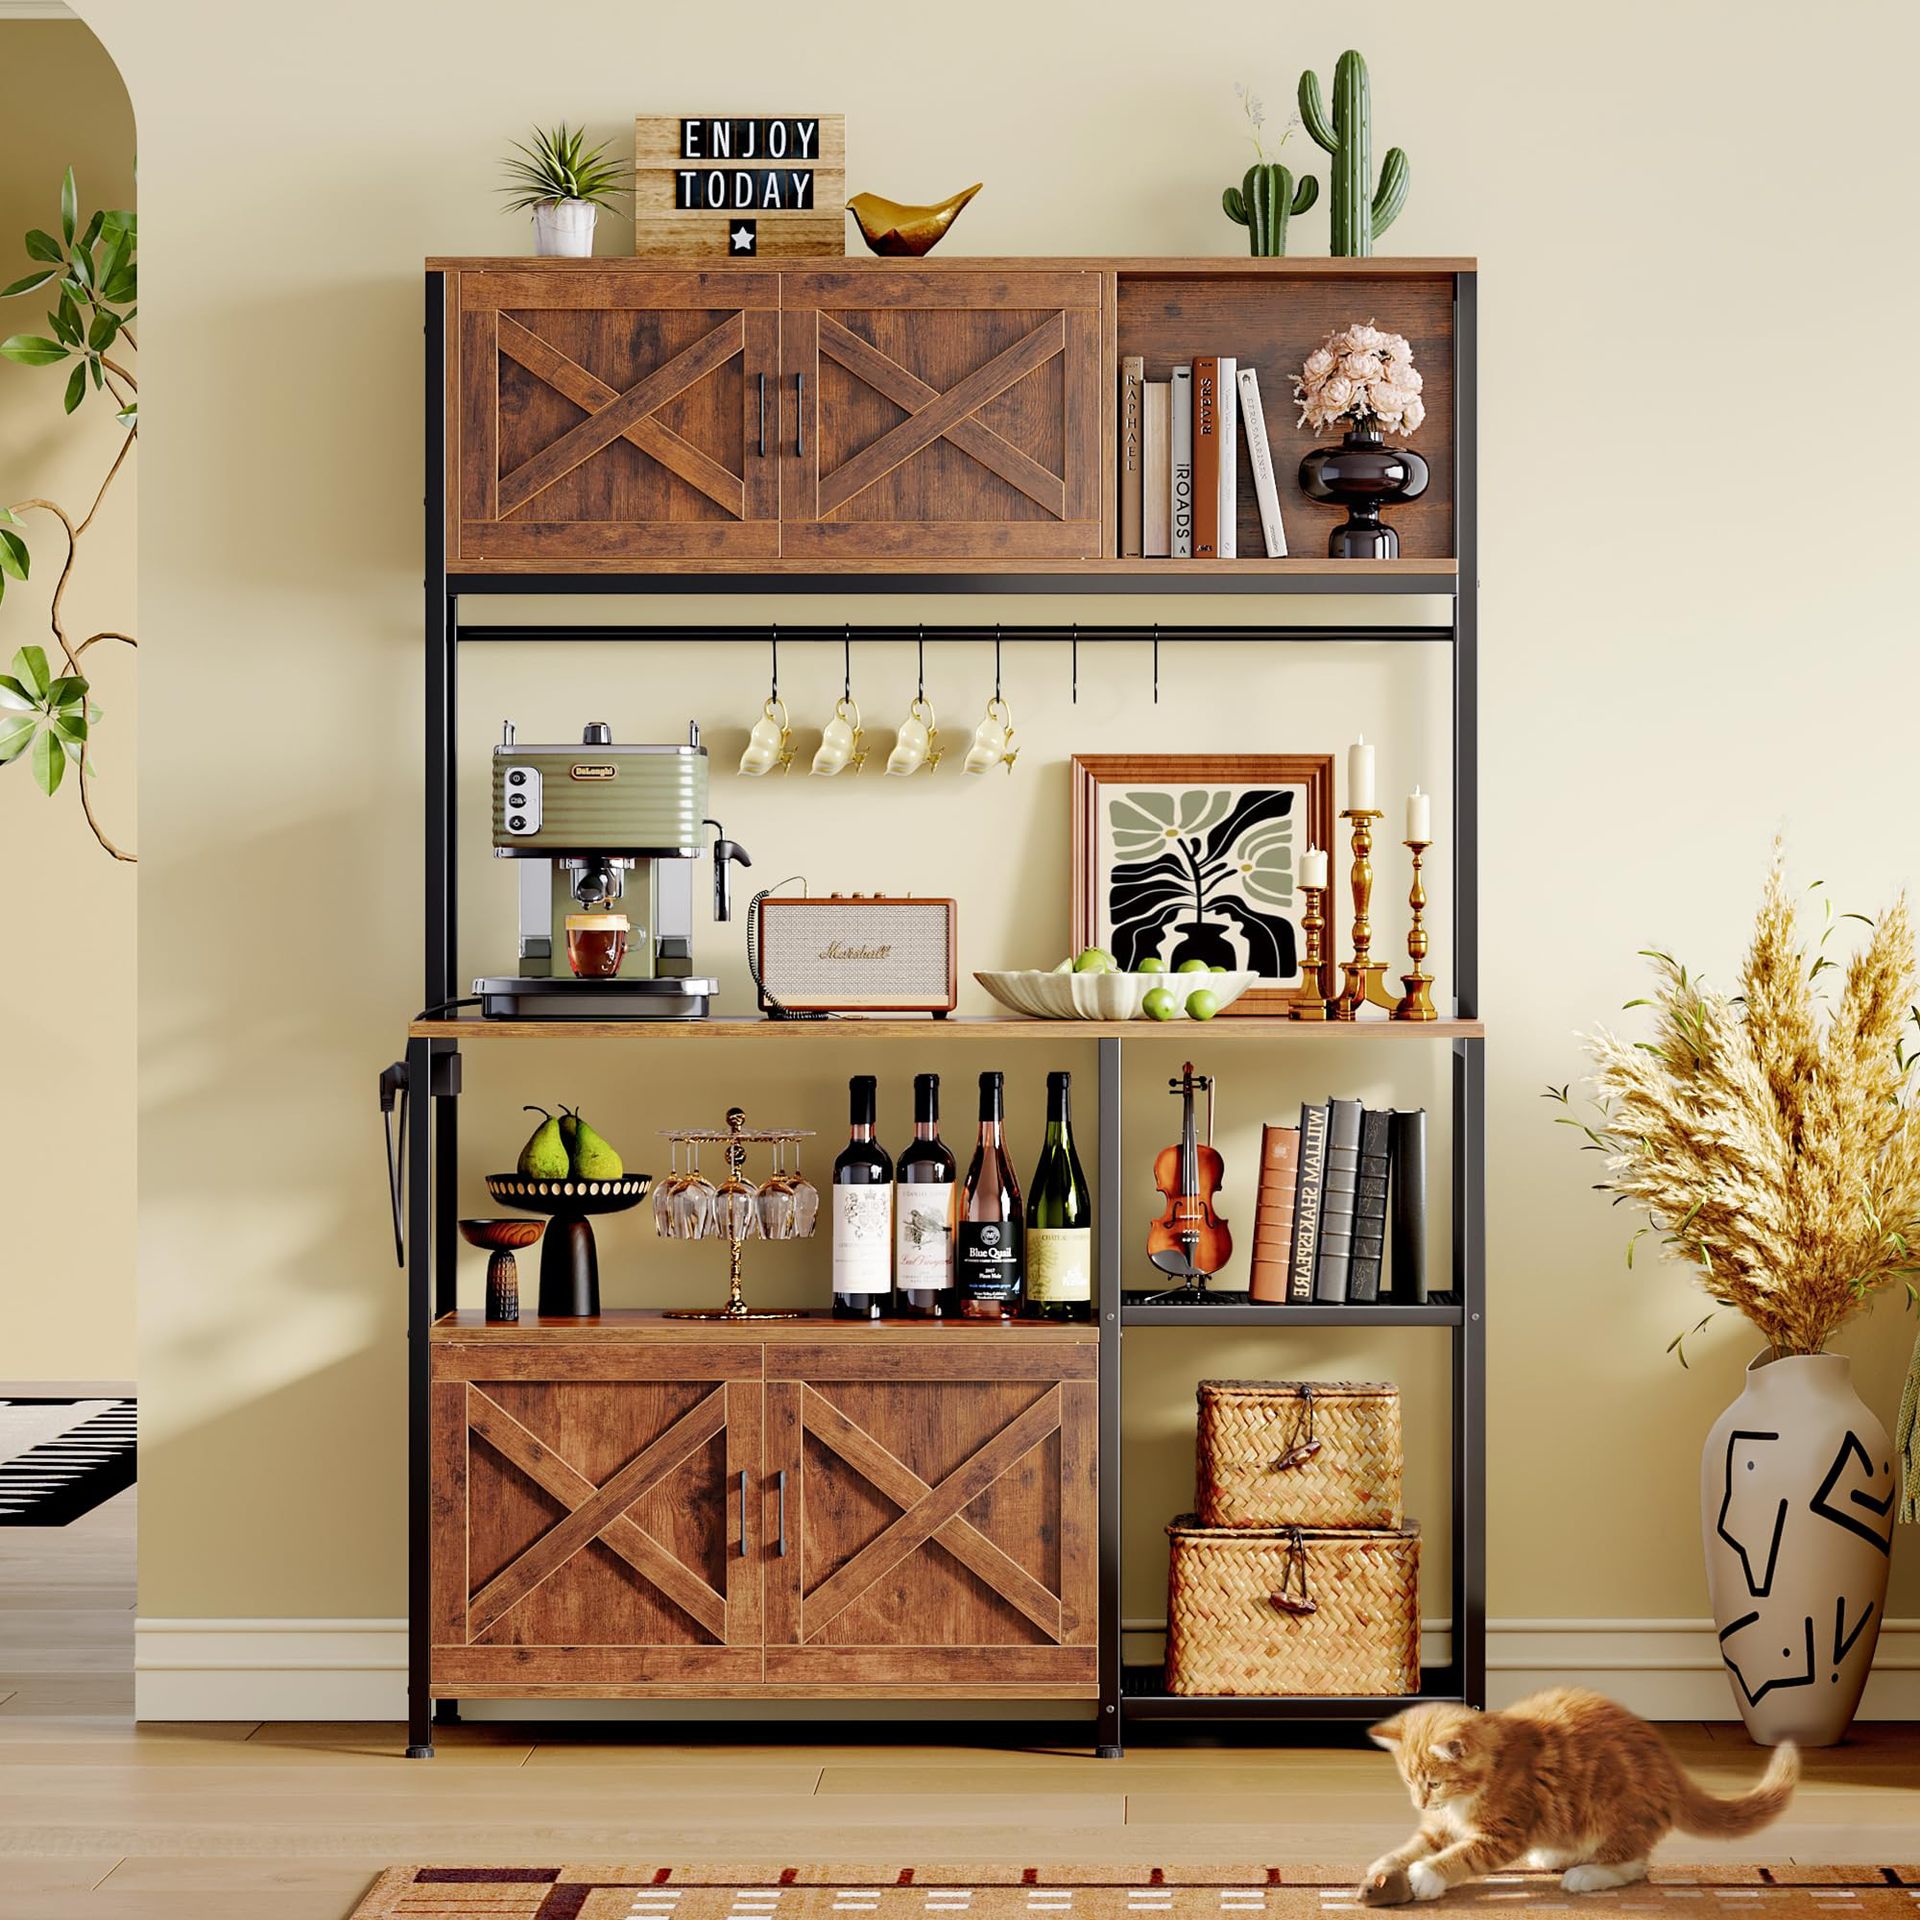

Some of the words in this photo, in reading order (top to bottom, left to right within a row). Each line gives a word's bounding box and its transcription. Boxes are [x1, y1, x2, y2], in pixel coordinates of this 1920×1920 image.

[686, 121, 815, 158] ENJOY
[680, 171, 810, 208] TODAY
[1126, 375, 1137, 471] RAPHAEL
[1200, 377, 1213, 436] RIVERS
[819, 940, 892, 960] Marshall
[969, 1247, 988, 1258] Blue
[988, 1247, 1012, 1260] Quail
